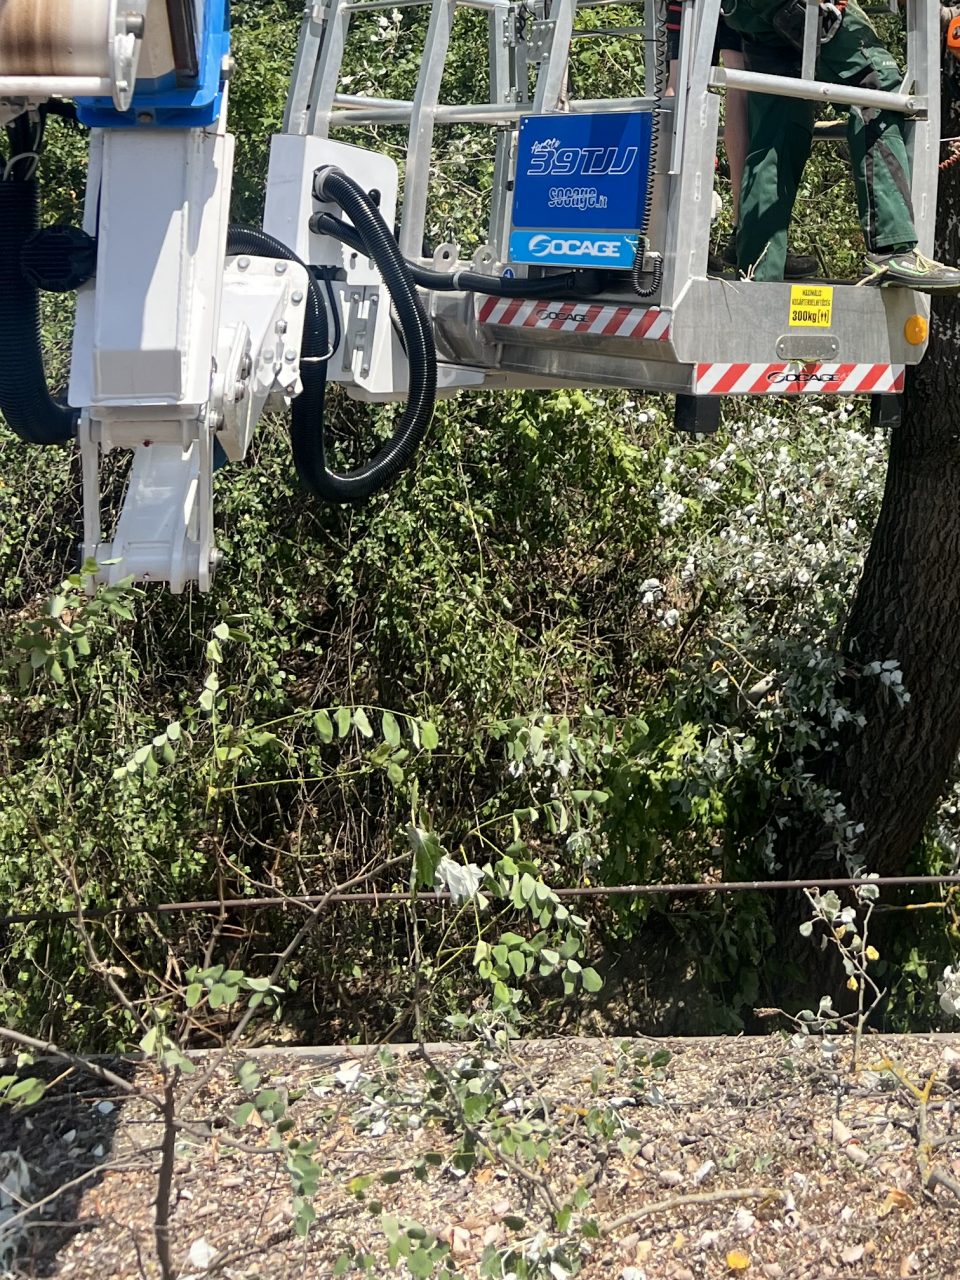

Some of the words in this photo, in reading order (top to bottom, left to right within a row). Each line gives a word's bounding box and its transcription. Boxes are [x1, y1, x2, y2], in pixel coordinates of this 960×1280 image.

[528, 234, 621, 257] SOCAGE
[536, 309, 590, 323] SOCAGE
[792, 310, 817, 324] 300kg
[767, 371, 840, 384] SOCAGE
